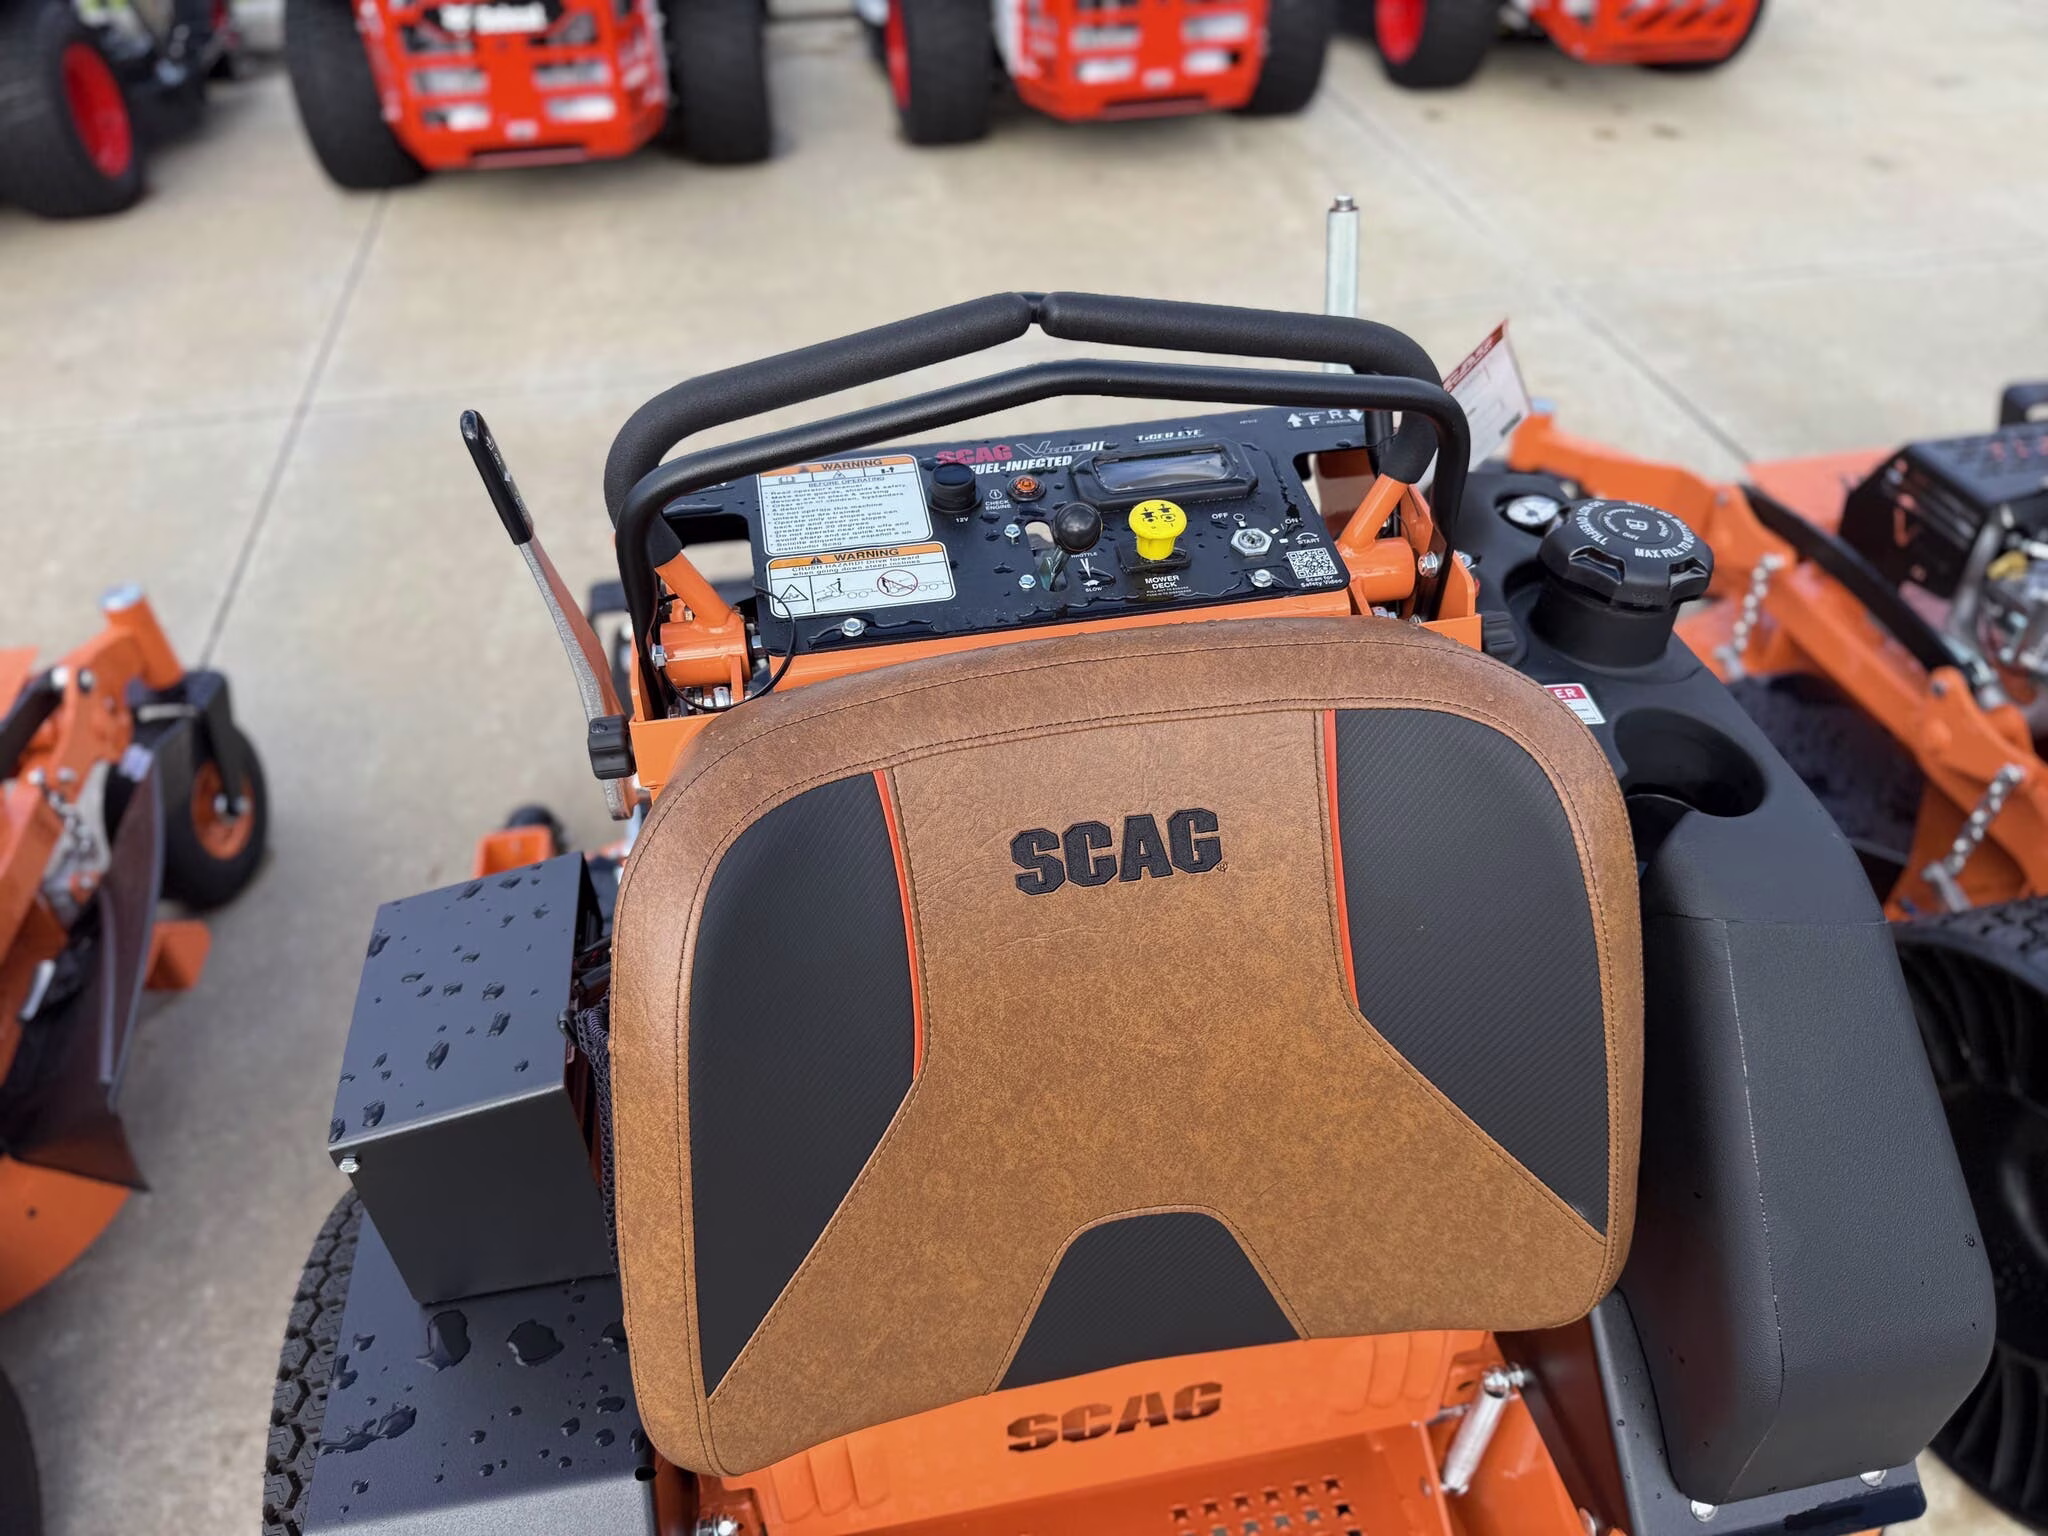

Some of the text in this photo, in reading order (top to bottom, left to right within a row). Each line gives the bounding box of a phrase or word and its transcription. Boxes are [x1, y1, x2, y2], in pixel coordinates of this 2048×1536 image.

[1327, 409, 1343, 419] R
[1308, 415, 1320, 425] F
[935, 444, 1013, 465] SCAG
[821, 459, 883, 470] WARNING
[969, 455, 1073, 475] FUEL-INJECTED
[985, 503, 1012, 511] ENGINE
[1211, 512, 1228, 520] OFF
[1576, 516, 1610, 546] OVERFILL
[1297, 537, 1320, 545] START
[834, 548, 899, 561] WARNING
[1634, 547, 1662, 559] MAX
[1660, 547, 1685, 559] FILL
[792, 564, 822, 572] CRUSH
[889, 554, 920, 562] forward
[1144, 574, 1179, 584] MOWER
[1151, 581, 1177, 589] DECK
[1010, 807, 1223, 895] SCAG
[1007, 1382, 1223, 1452] SCAG
